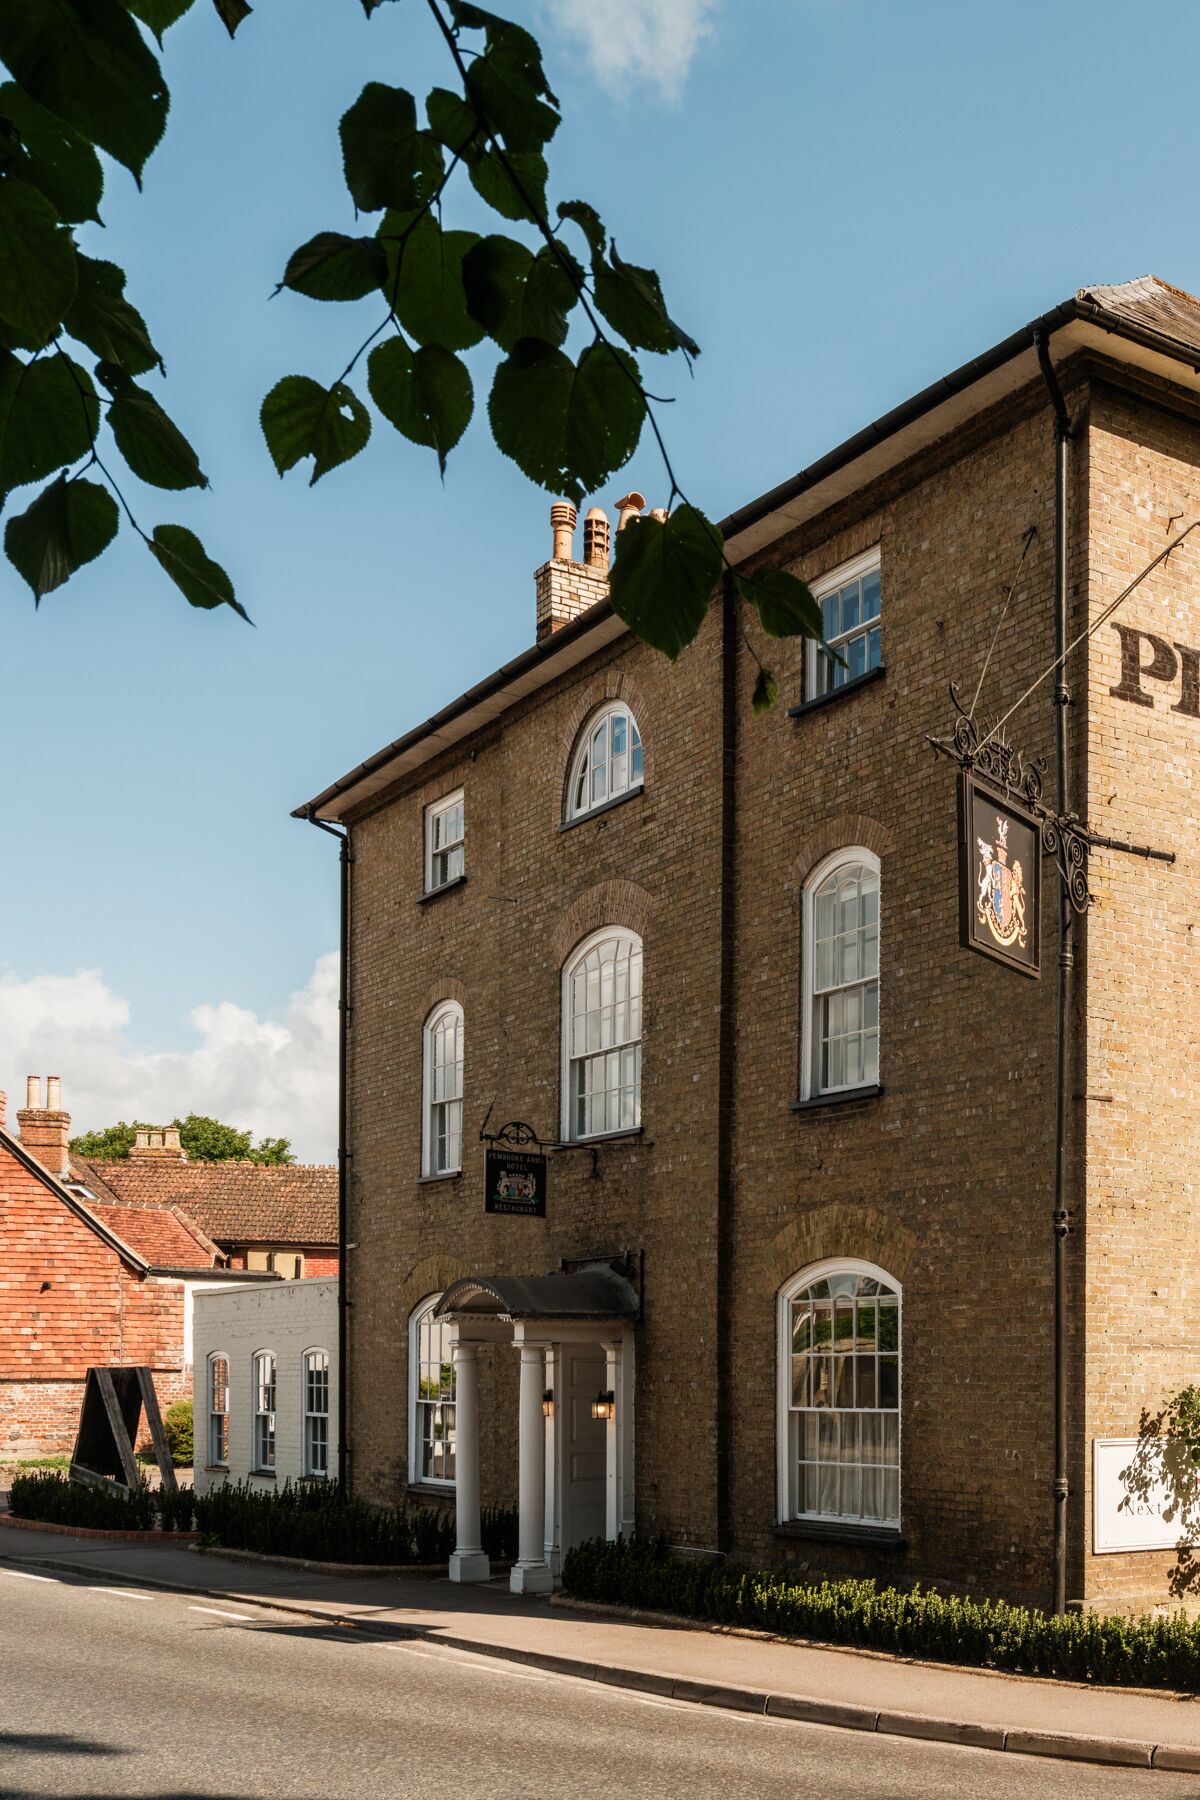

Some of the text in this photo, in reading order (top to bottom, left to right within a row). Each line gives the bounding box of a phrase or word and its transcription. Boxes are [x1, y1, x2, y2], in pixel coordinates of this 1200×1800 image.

[488, 1152, 524, 1163] PEMBROKE
[506, 1163, 527, 1171] HOTEL
[494, 1203, 537, 1213] RESTAURANT
[1124, 1499, 1162, 1517] Next
